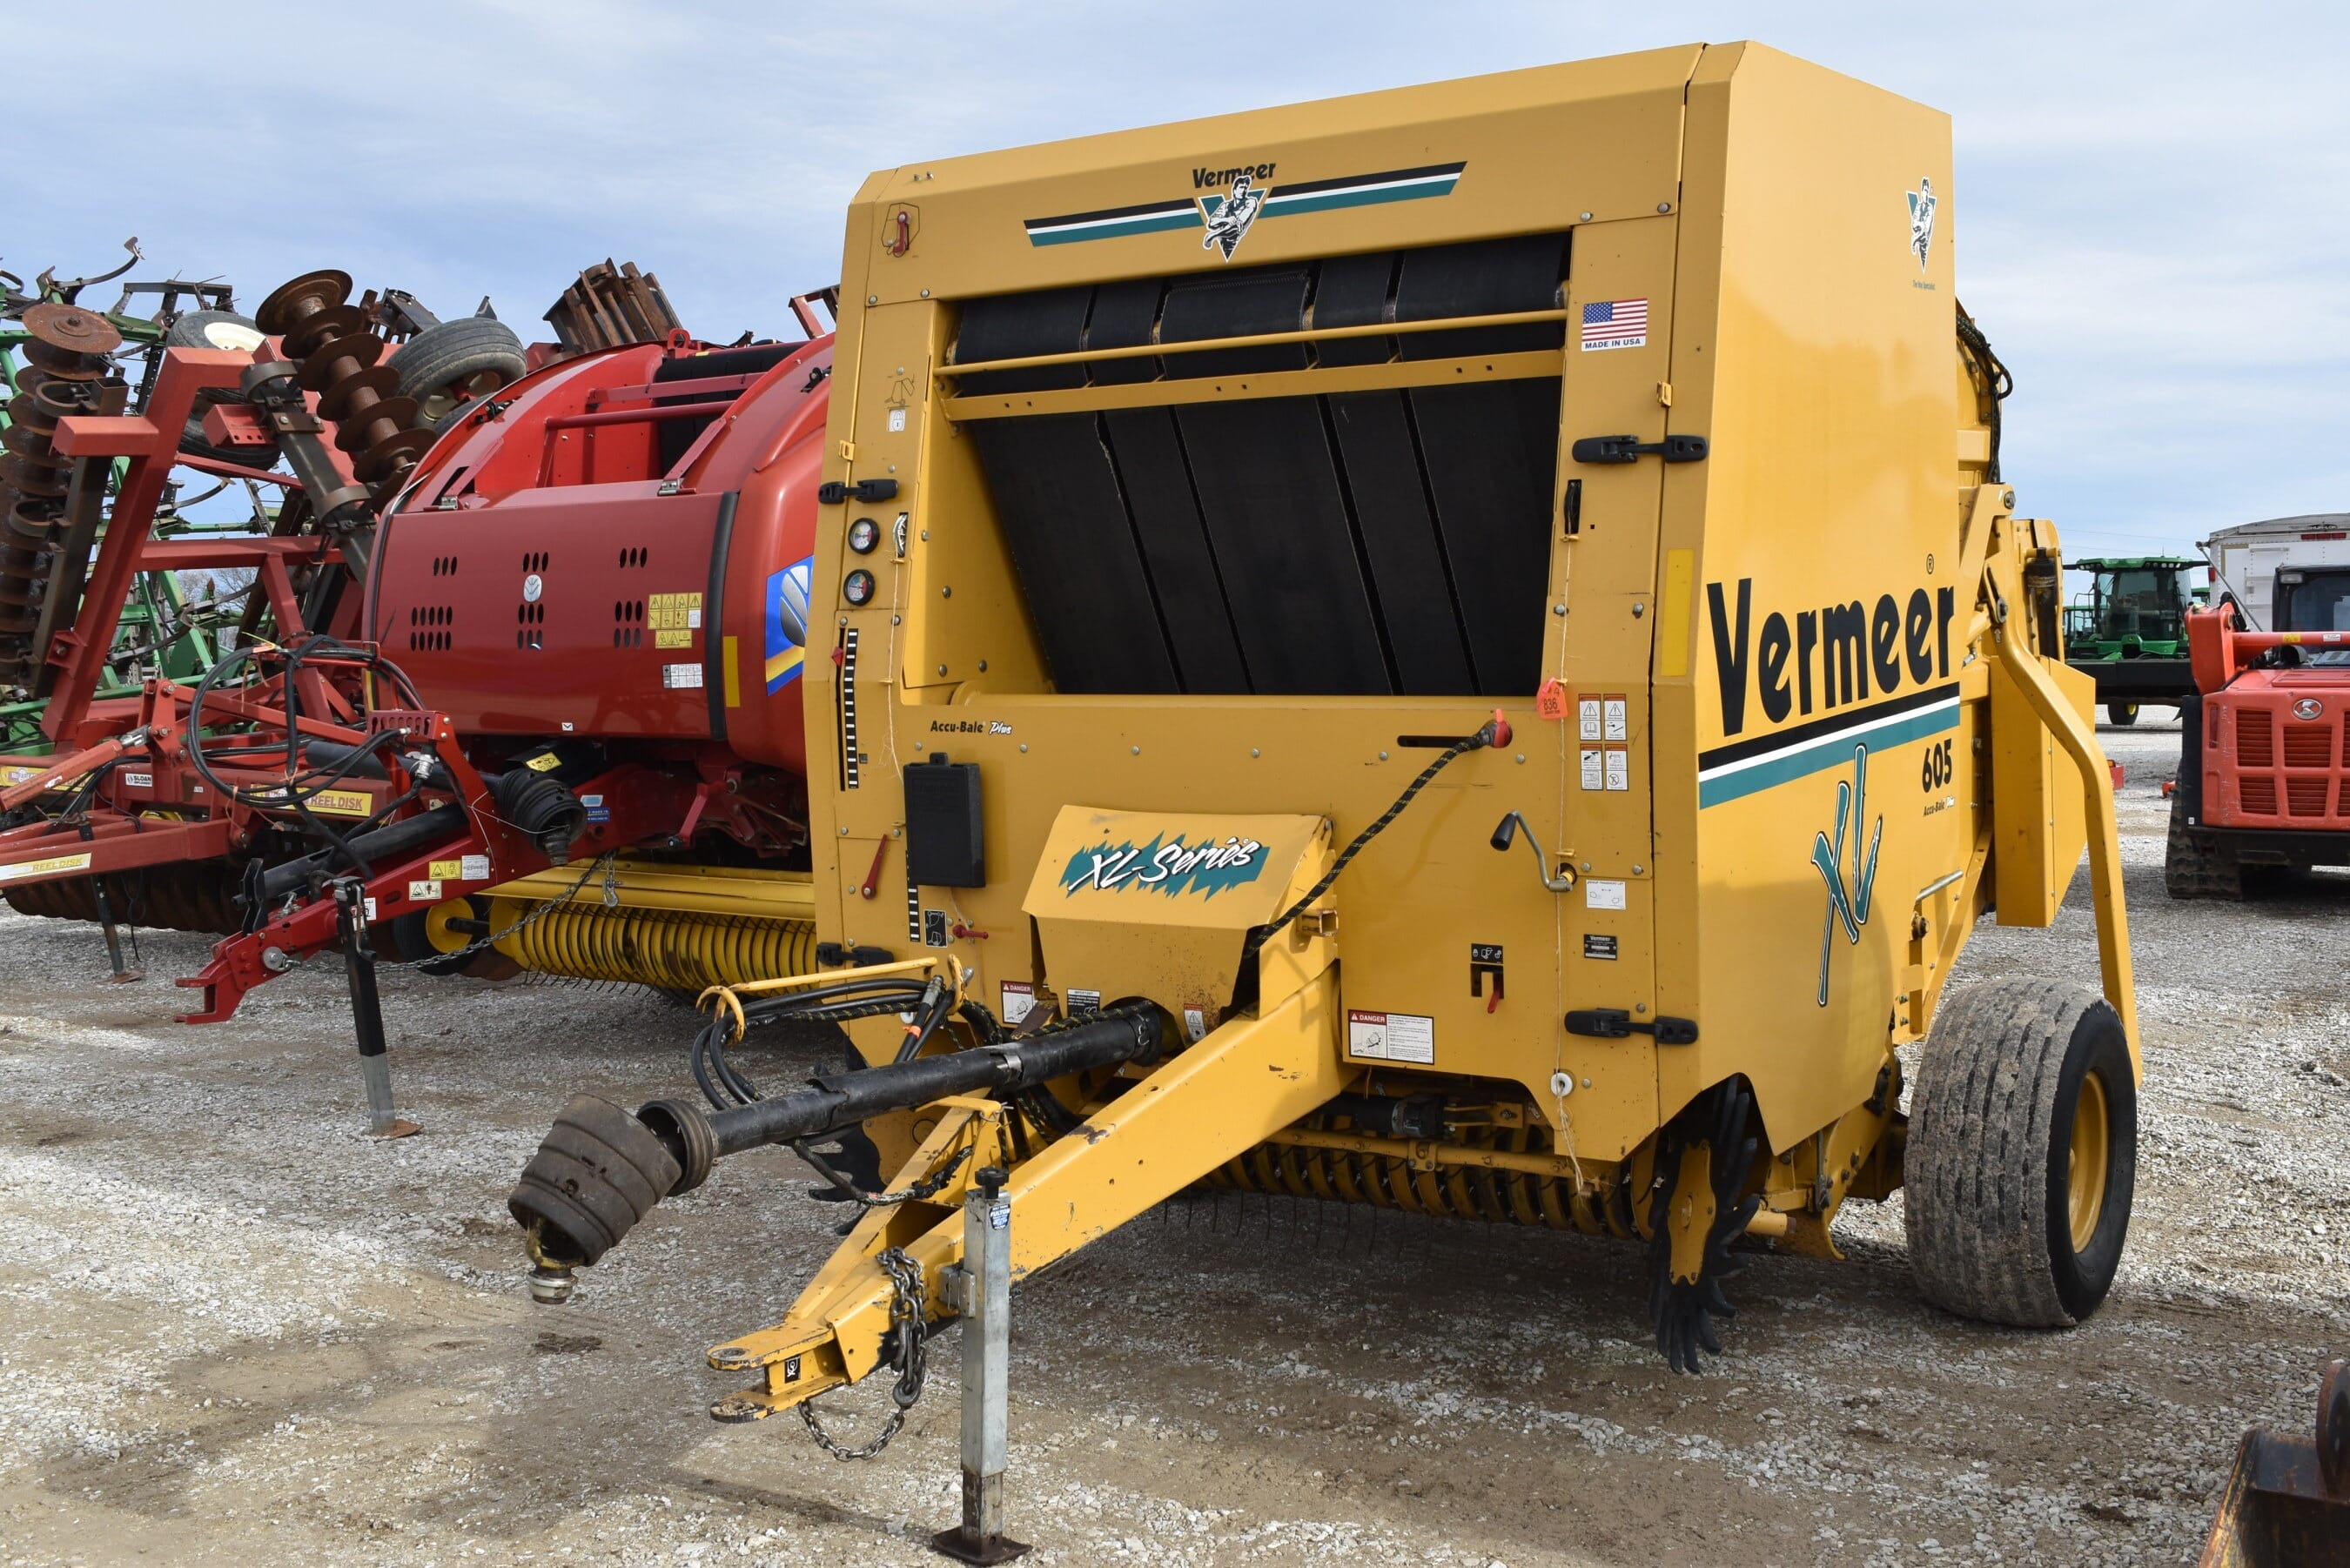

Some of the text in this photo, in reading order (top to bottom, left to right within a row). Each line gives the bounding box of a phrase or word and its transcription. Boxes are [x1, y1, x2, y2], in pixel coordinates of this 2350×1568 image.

[1192, 163, 1277, 189] Vermeer
[1706, 577, 1955, 737] Vermeer
[1543, 697, 1558, 711] 836
[930, 720, 1012, 735] Accu-Bale Plus
[1922, 738, 1952, 794] 605
[311, 794, 363, 809] REEL DISK
[33, 857, 84, 872] REEL DISK
[1810, 741, 1883, 1006] XL
[1359, 1014, 1386, 1022] DANGER
